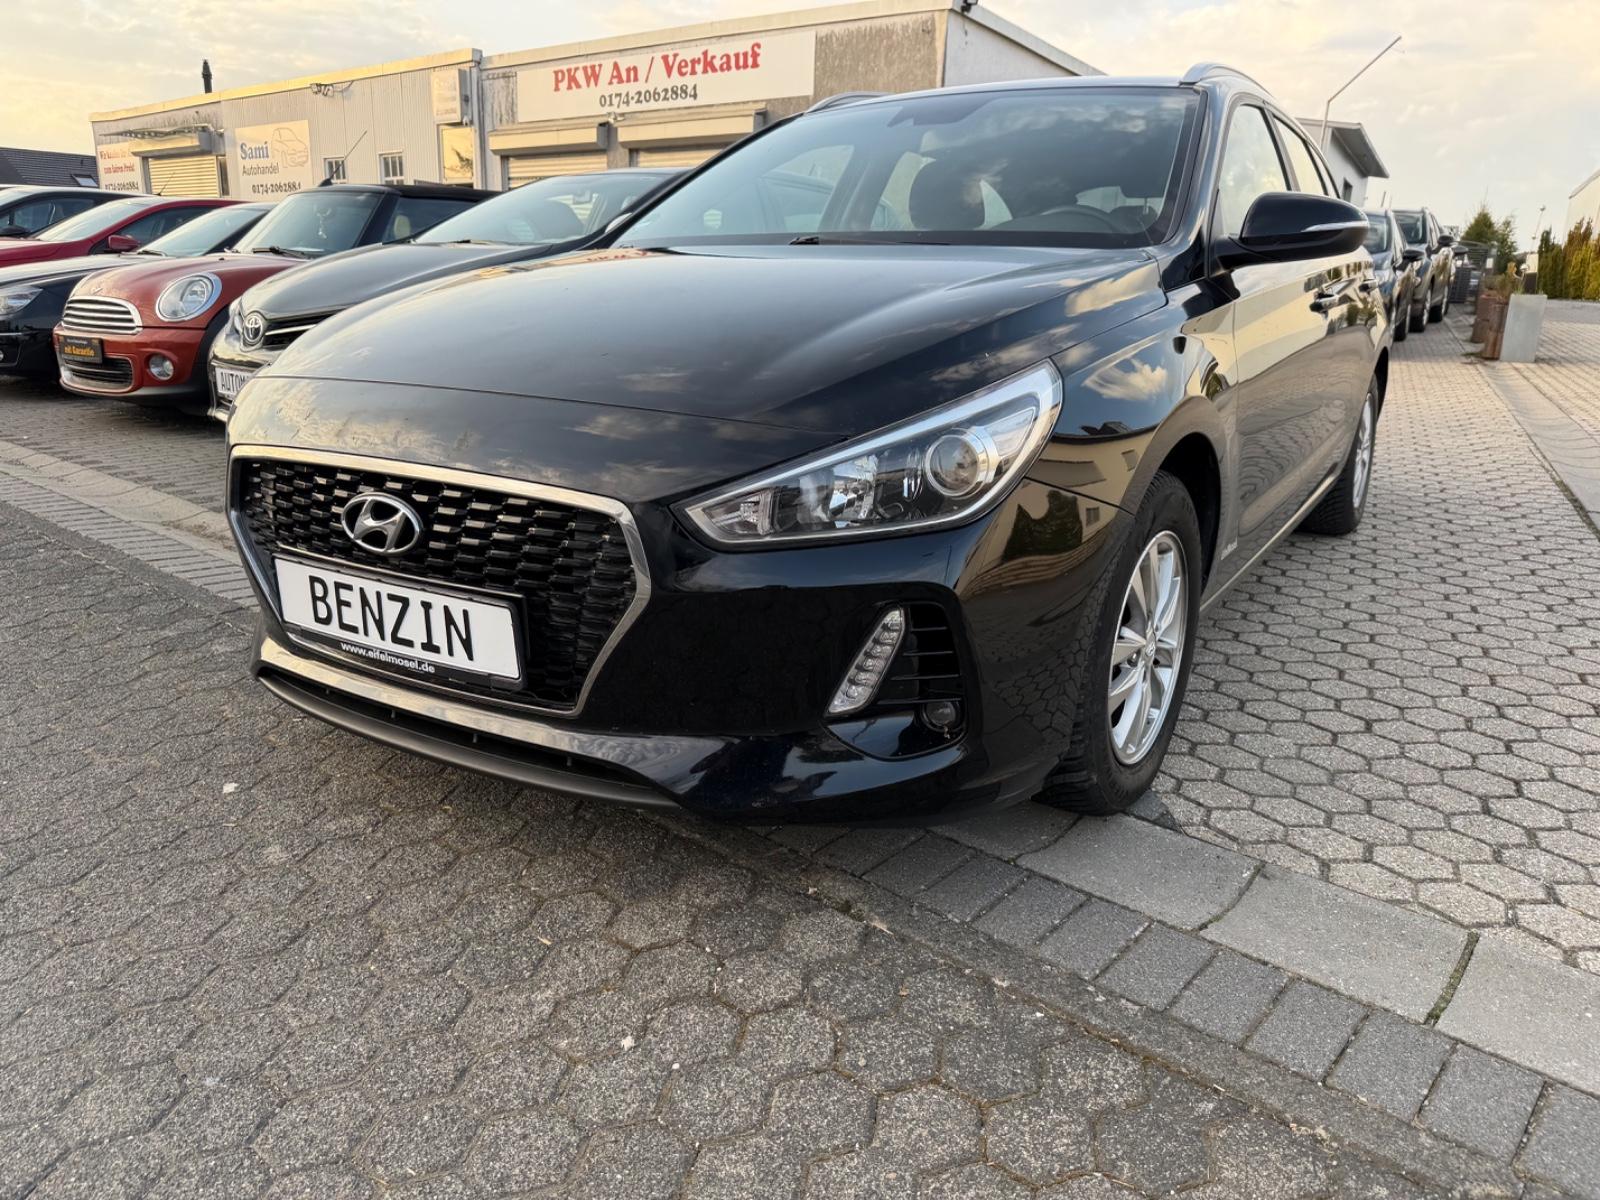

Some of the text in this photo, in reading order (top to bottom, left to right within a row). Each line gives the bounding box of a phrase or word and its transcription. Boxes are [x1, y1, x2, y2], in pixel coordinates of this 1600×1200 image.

[553, 42, 762, 92] PKW An / Verkauf
[240, 141, 269, 160] Sami
[242, 162, 279, 176] Autohandel
[220, 371, 249, 393] AUTOM
[308, 575, 474, 662] BENZIN
[340, 642, 436, 674] www.eifelmosel.de
